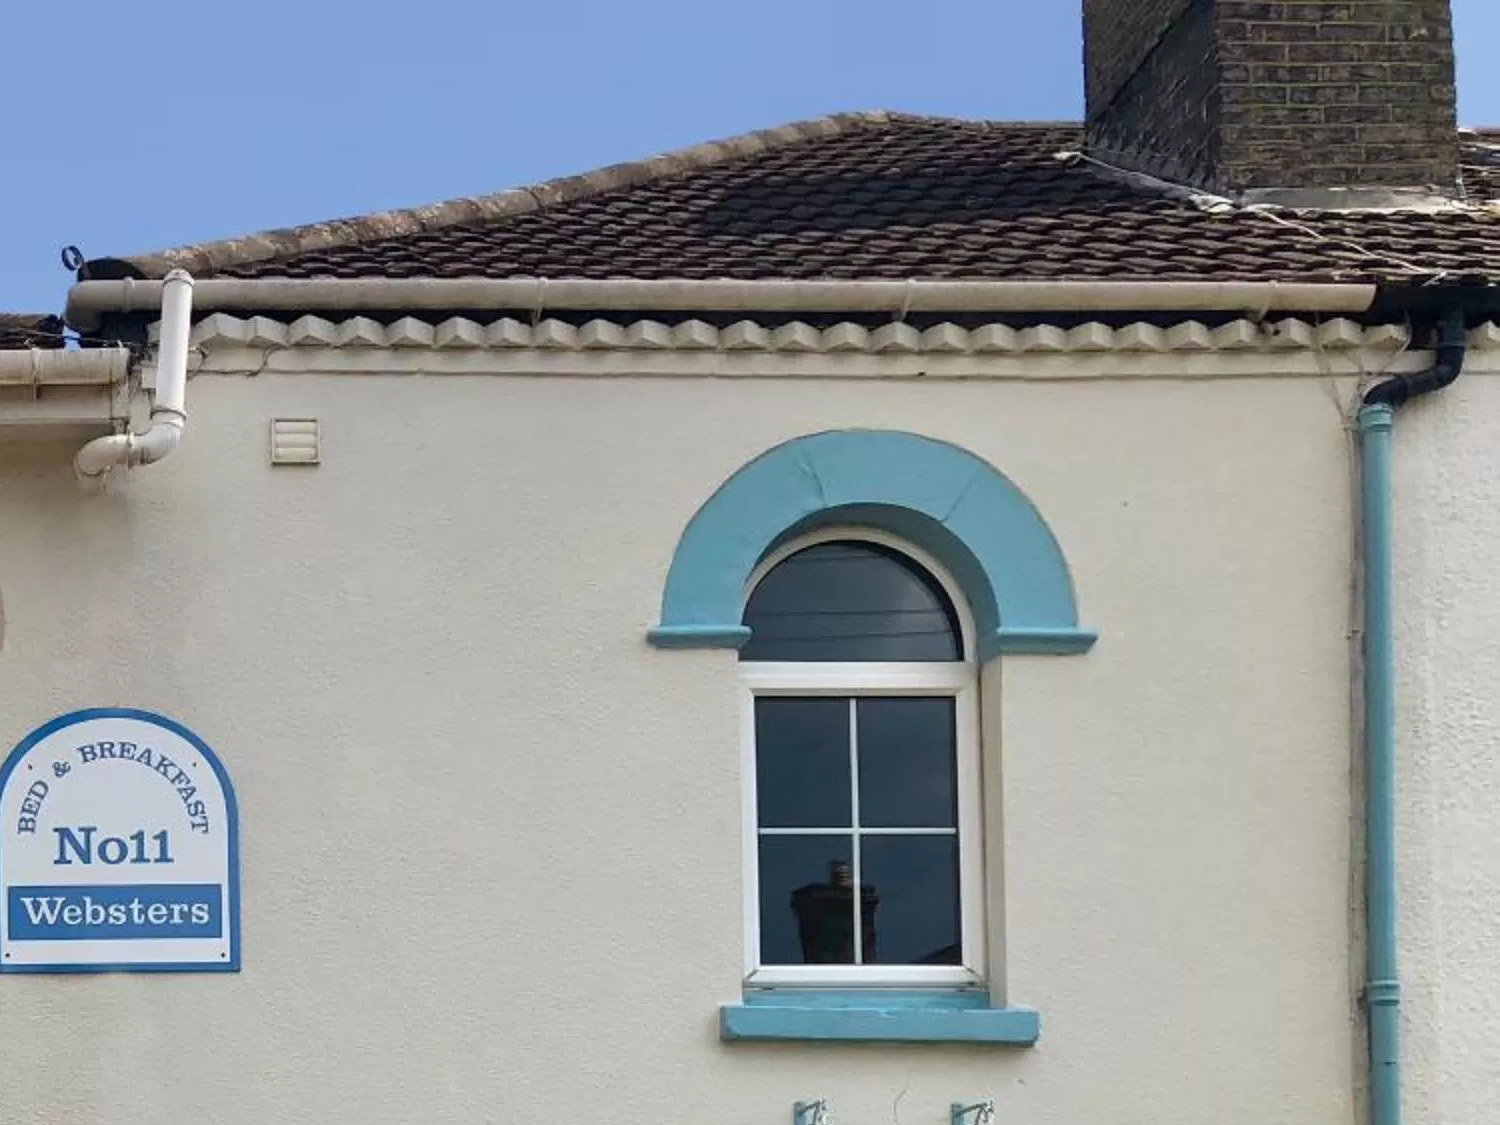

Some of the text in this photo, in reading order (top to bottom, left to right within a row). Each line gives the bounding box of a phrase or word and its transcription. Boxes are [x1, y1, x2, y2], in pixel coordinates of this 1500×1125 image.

[18, 741, 209, 834] BED & BREAKFAST
[53, 826, 174, 865] No11
[20, 896, 210, 925] Websters
